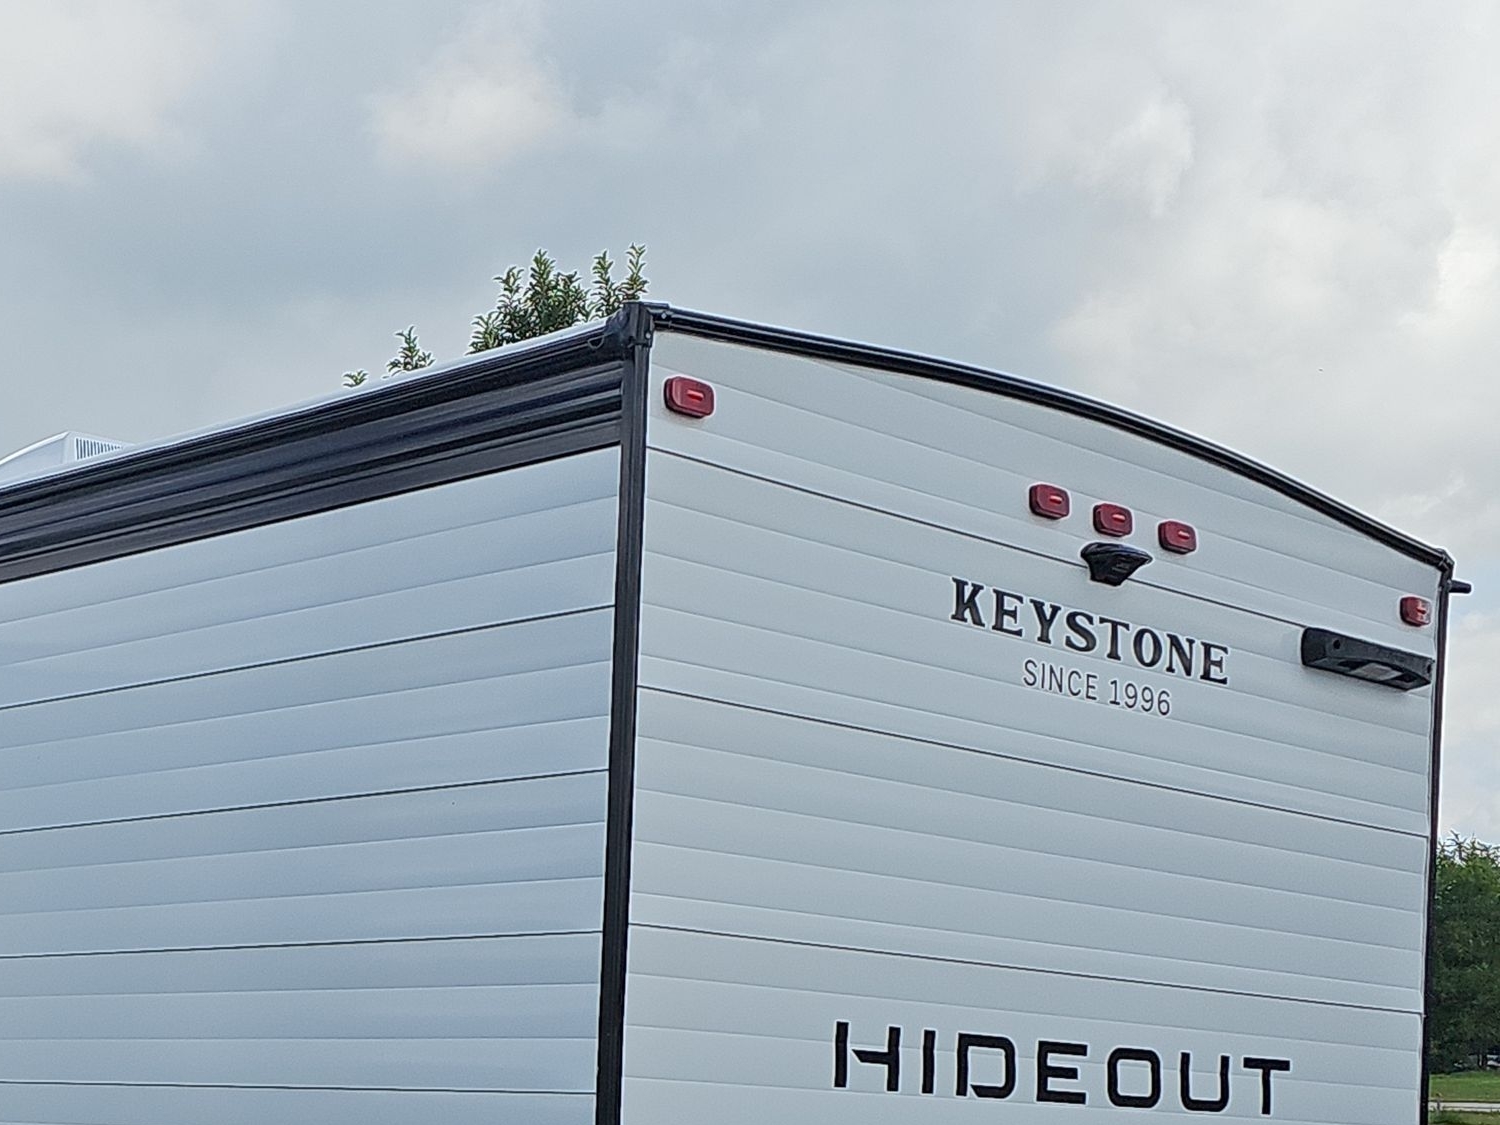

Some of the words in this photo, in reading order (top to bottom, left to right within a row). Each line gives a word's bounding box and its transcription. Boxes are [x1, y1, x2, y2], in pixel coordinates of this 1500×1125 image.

[951, 577, 1229, 685] KEYSTONE
[1023, 659, 1098, 700] SINCE
[1109, 680, 1171, 715] 1996
[833, 1021, 1291, 1116] HIDEOUT
